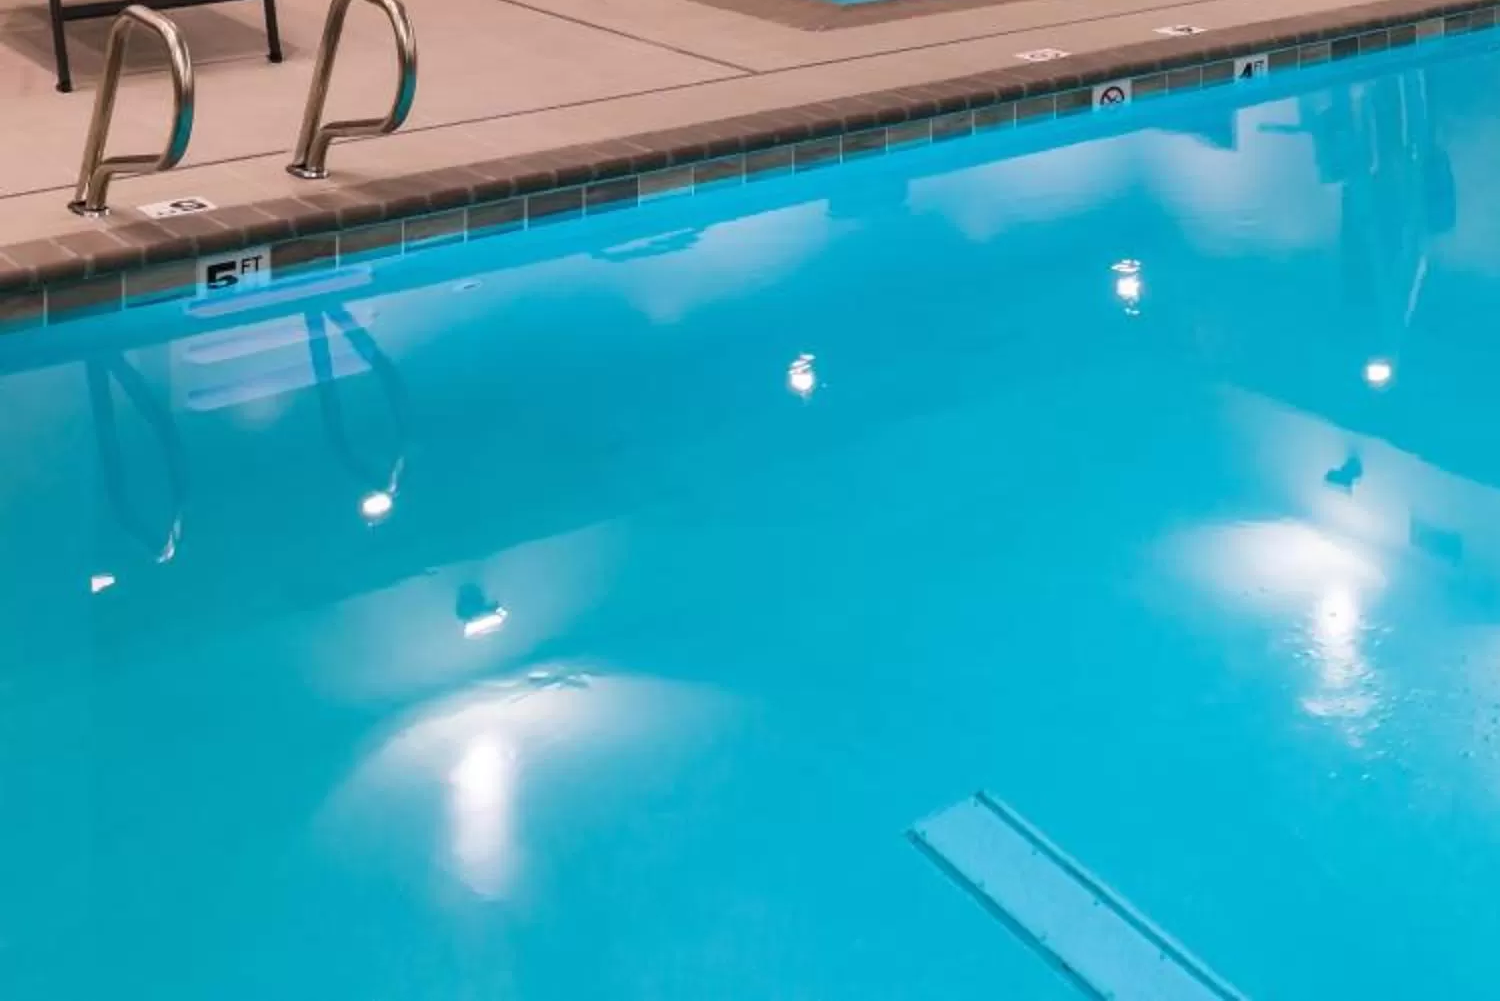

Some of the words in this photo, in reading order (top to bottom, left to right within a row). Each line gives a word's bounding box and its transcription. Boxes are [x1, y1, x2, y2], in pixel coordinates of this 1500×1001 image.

[1239, 62, 1253, 79] 4
[206, 260, 239, 290] 5
[240, 255, 263, 275] FT
